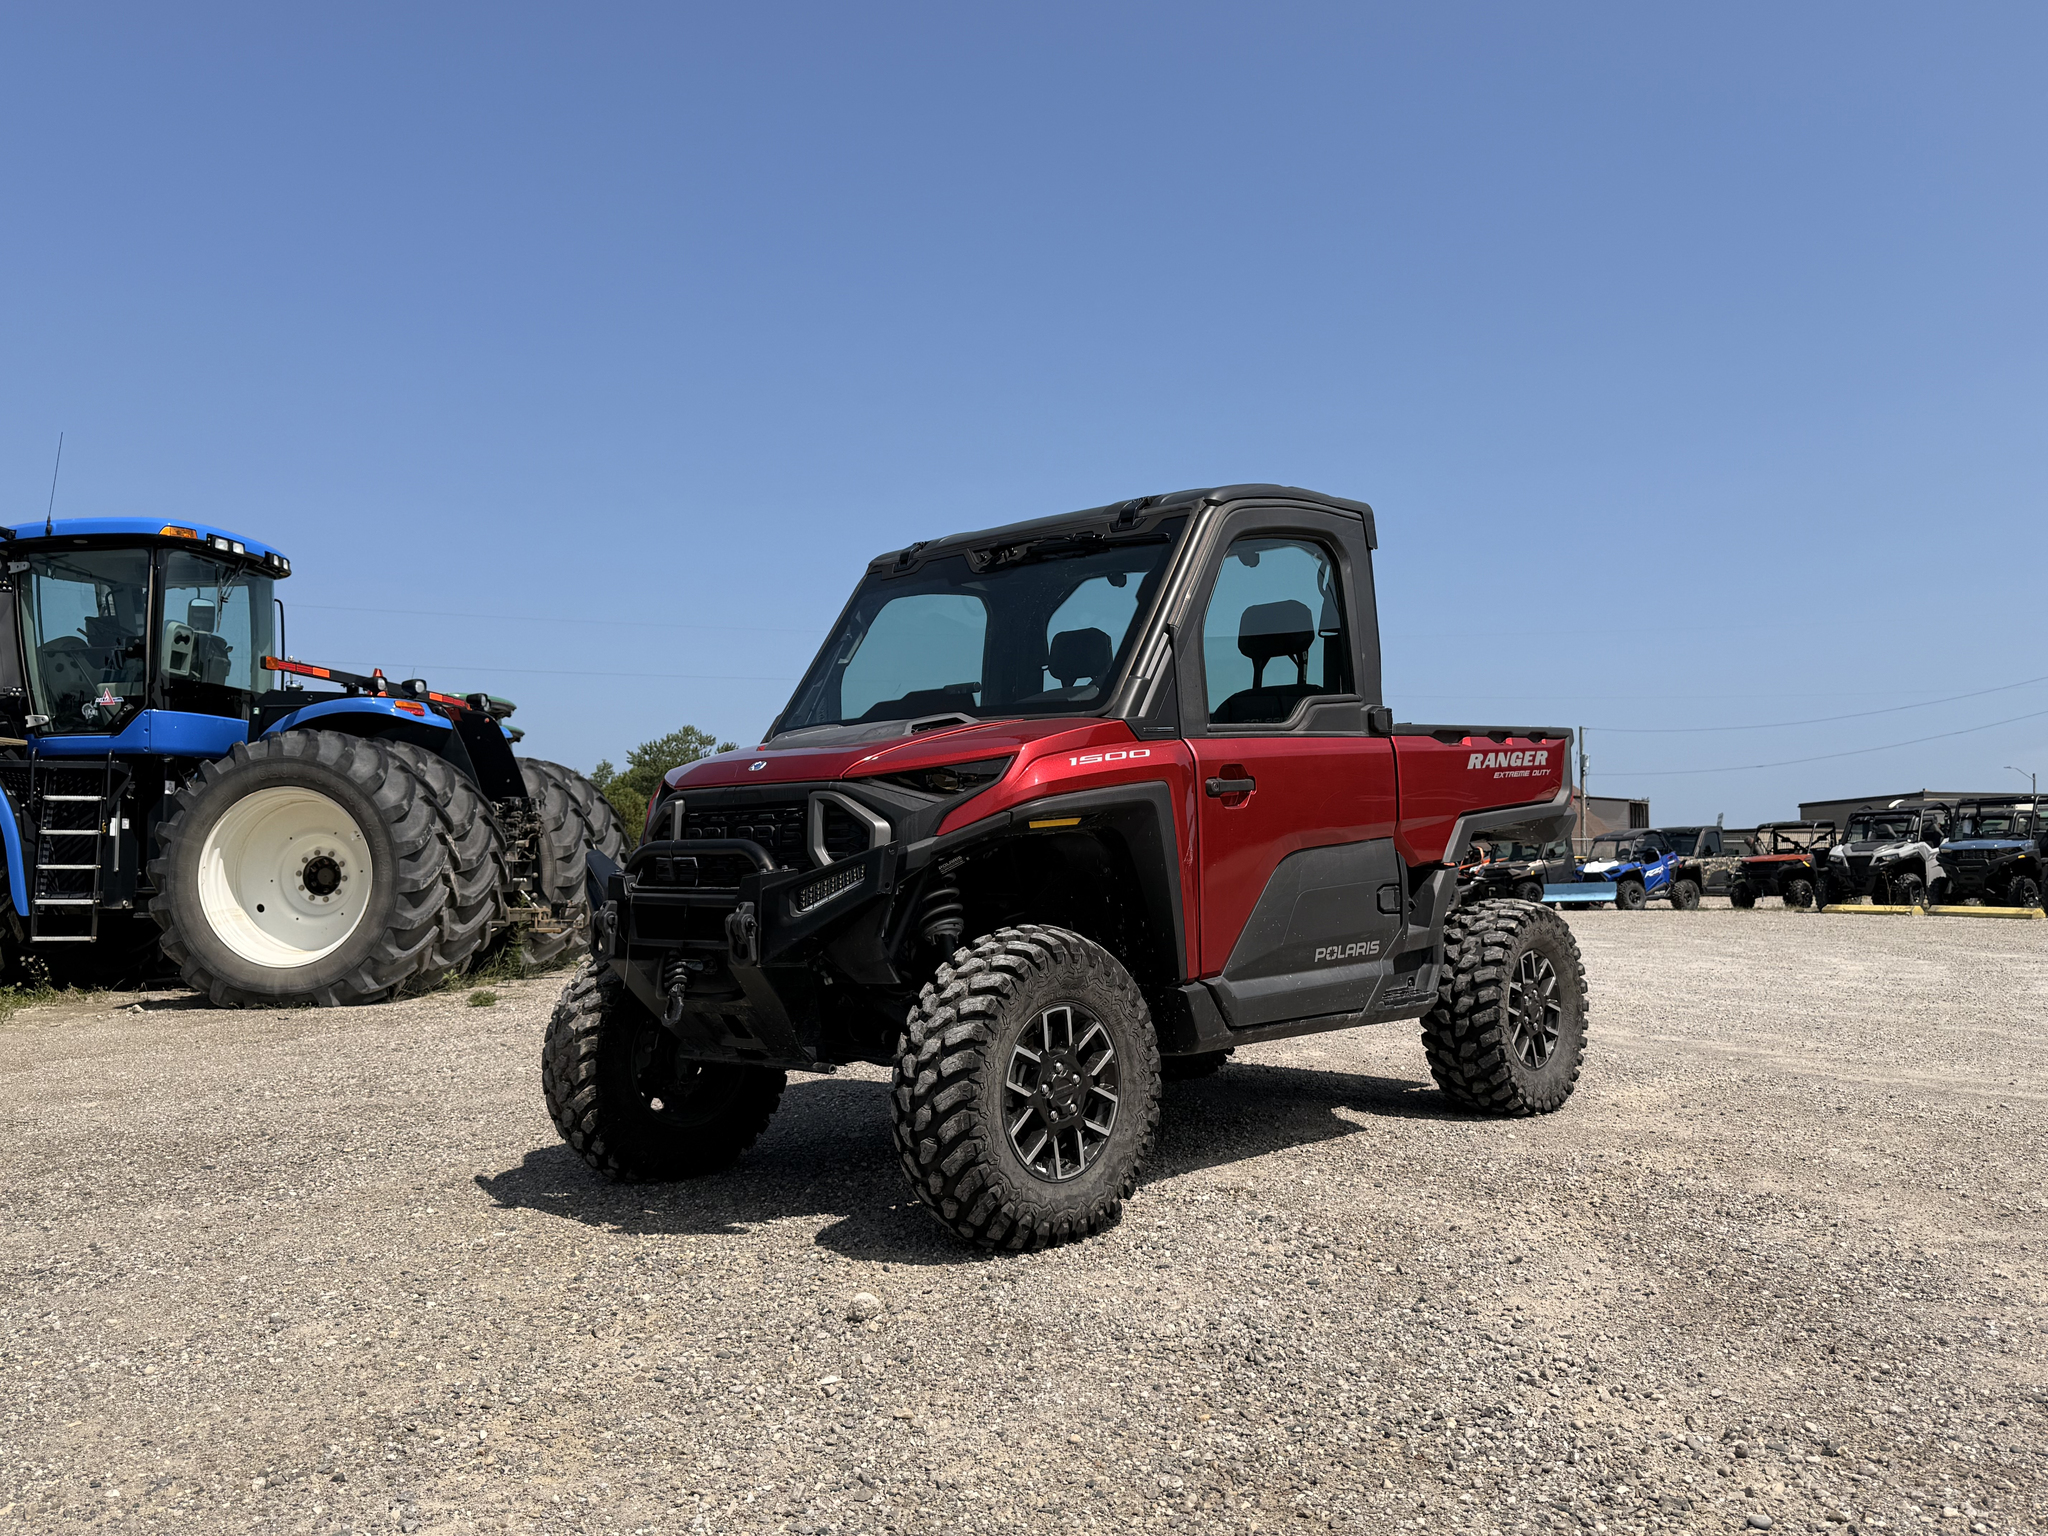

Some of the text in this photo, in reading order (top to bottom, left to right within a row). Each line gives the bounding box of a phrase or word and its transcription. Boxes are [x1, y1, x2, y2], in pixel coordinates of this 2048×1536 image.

[1069, 748, 1151, 767] 1500
[1467, 750, 1549, 770] RANGER
[1493, 768, 1551, 779] EXTREME DUTY
[1314, 940, 1381, 963] POLARIS
